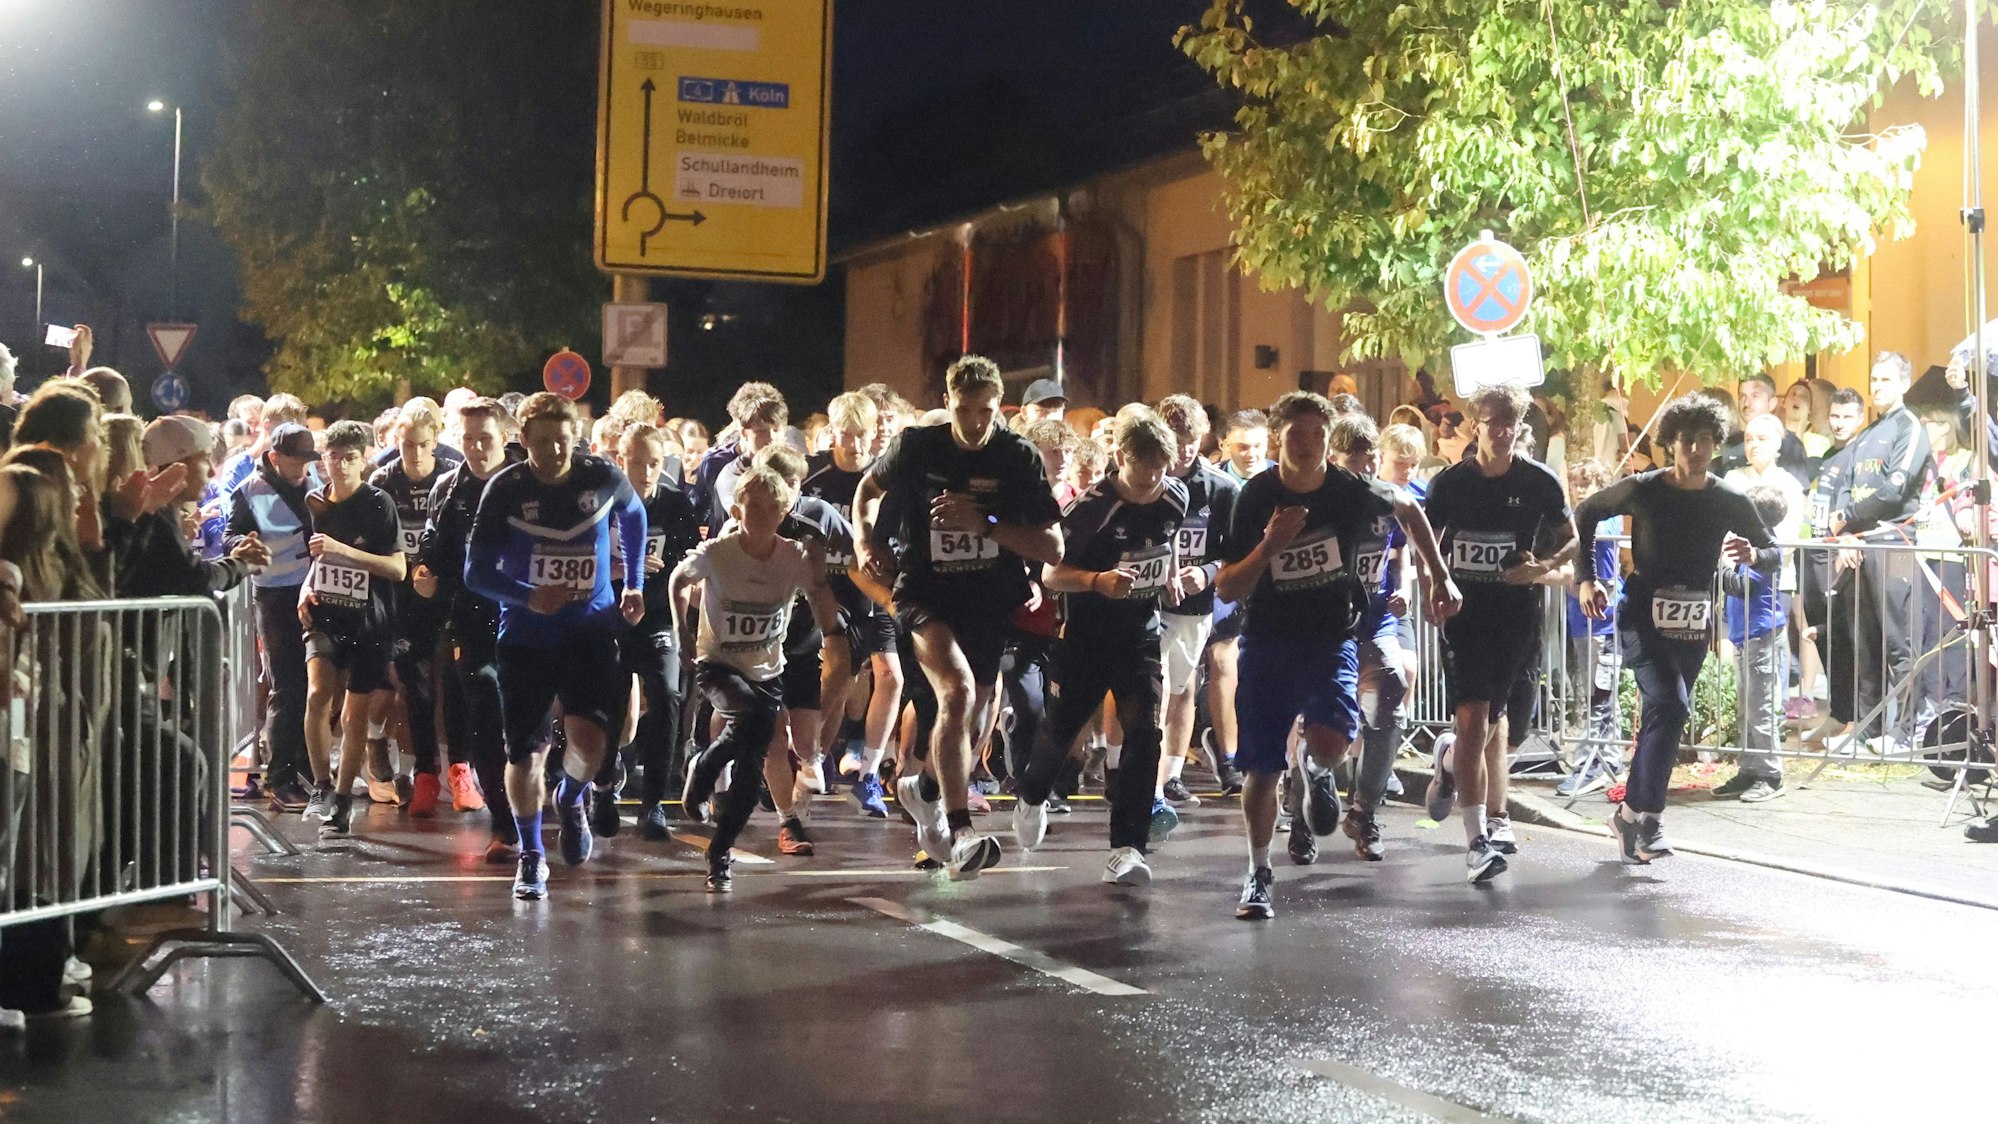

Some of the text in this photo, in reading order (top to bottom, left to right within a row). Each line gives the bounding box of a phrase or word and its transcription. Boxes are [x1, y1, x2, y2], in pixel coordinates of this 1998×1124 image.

[629, 0, 763, 19] Wegeringhausen
[749, 85, 785, 103] Köln
[677, 109, 748, 128] Waldbröl
[680, 156, 799, 178] Schullandheim
[708, 182, 765, 200] Dreiort
[941, 533, 984, 554] 541
[1179, 529, 1205, 549] 97
[1279, 543, 1329, 572] 285
[319, 566, 366, 591] 1152
[535, 558, 595, 580] 1380
[1656, 601, 1707, 621] 1213
[726, 612, 782, 636] 1078
